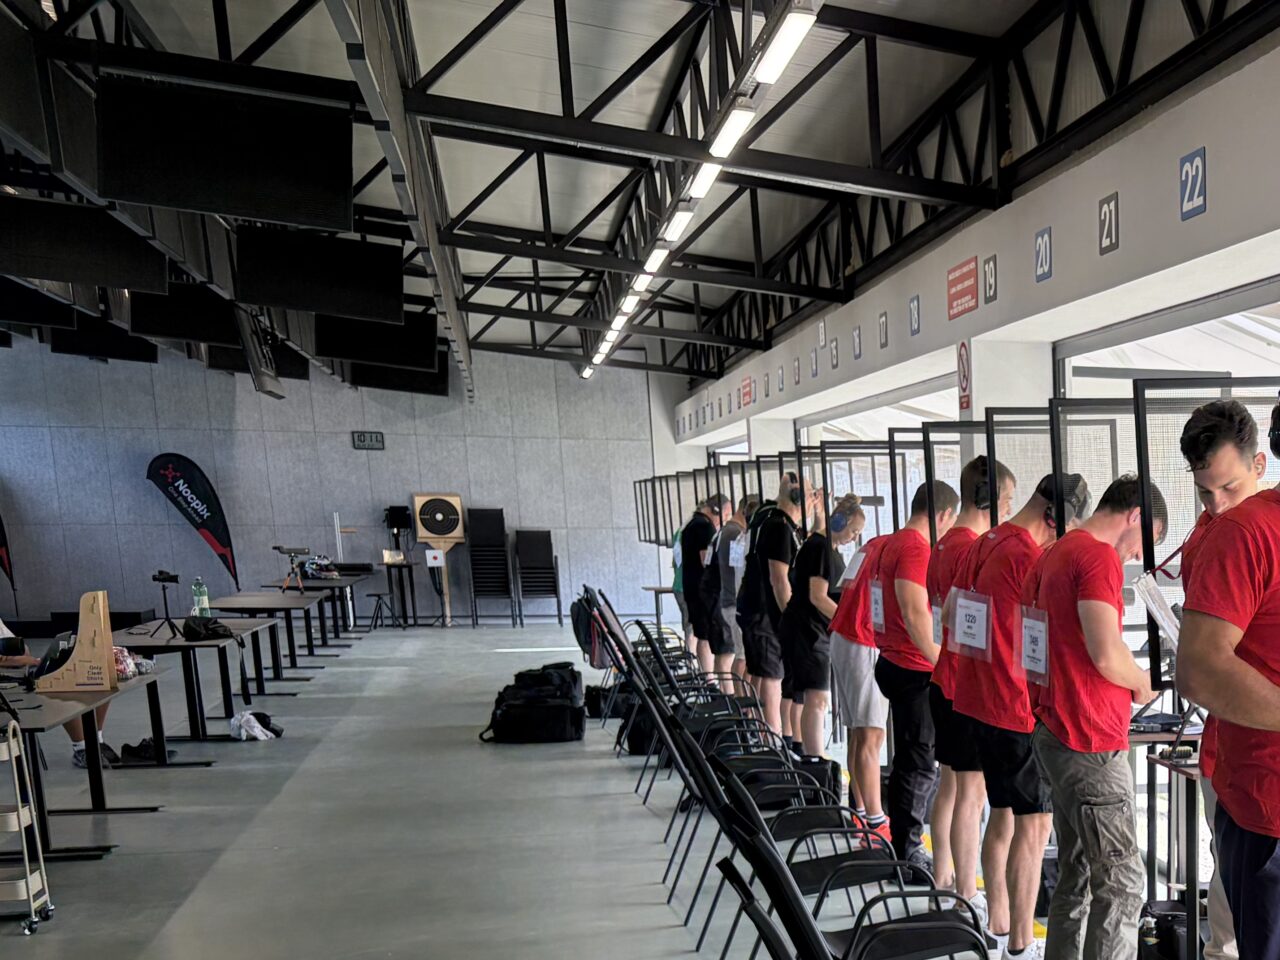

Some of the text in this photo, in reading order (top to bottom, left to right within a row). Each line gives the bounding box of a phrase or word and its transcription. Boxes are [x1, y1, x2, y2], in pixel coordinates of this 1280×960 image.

[1182, 156, 1204, 213] 22
[1101, 200, 1116, 248] 21
[1036, 233, 1050, 276] 20
[985, 261, 996, 297] 19
[910, 299, 919, 331] 18
[174, 478, 211, 520] Nocpix
